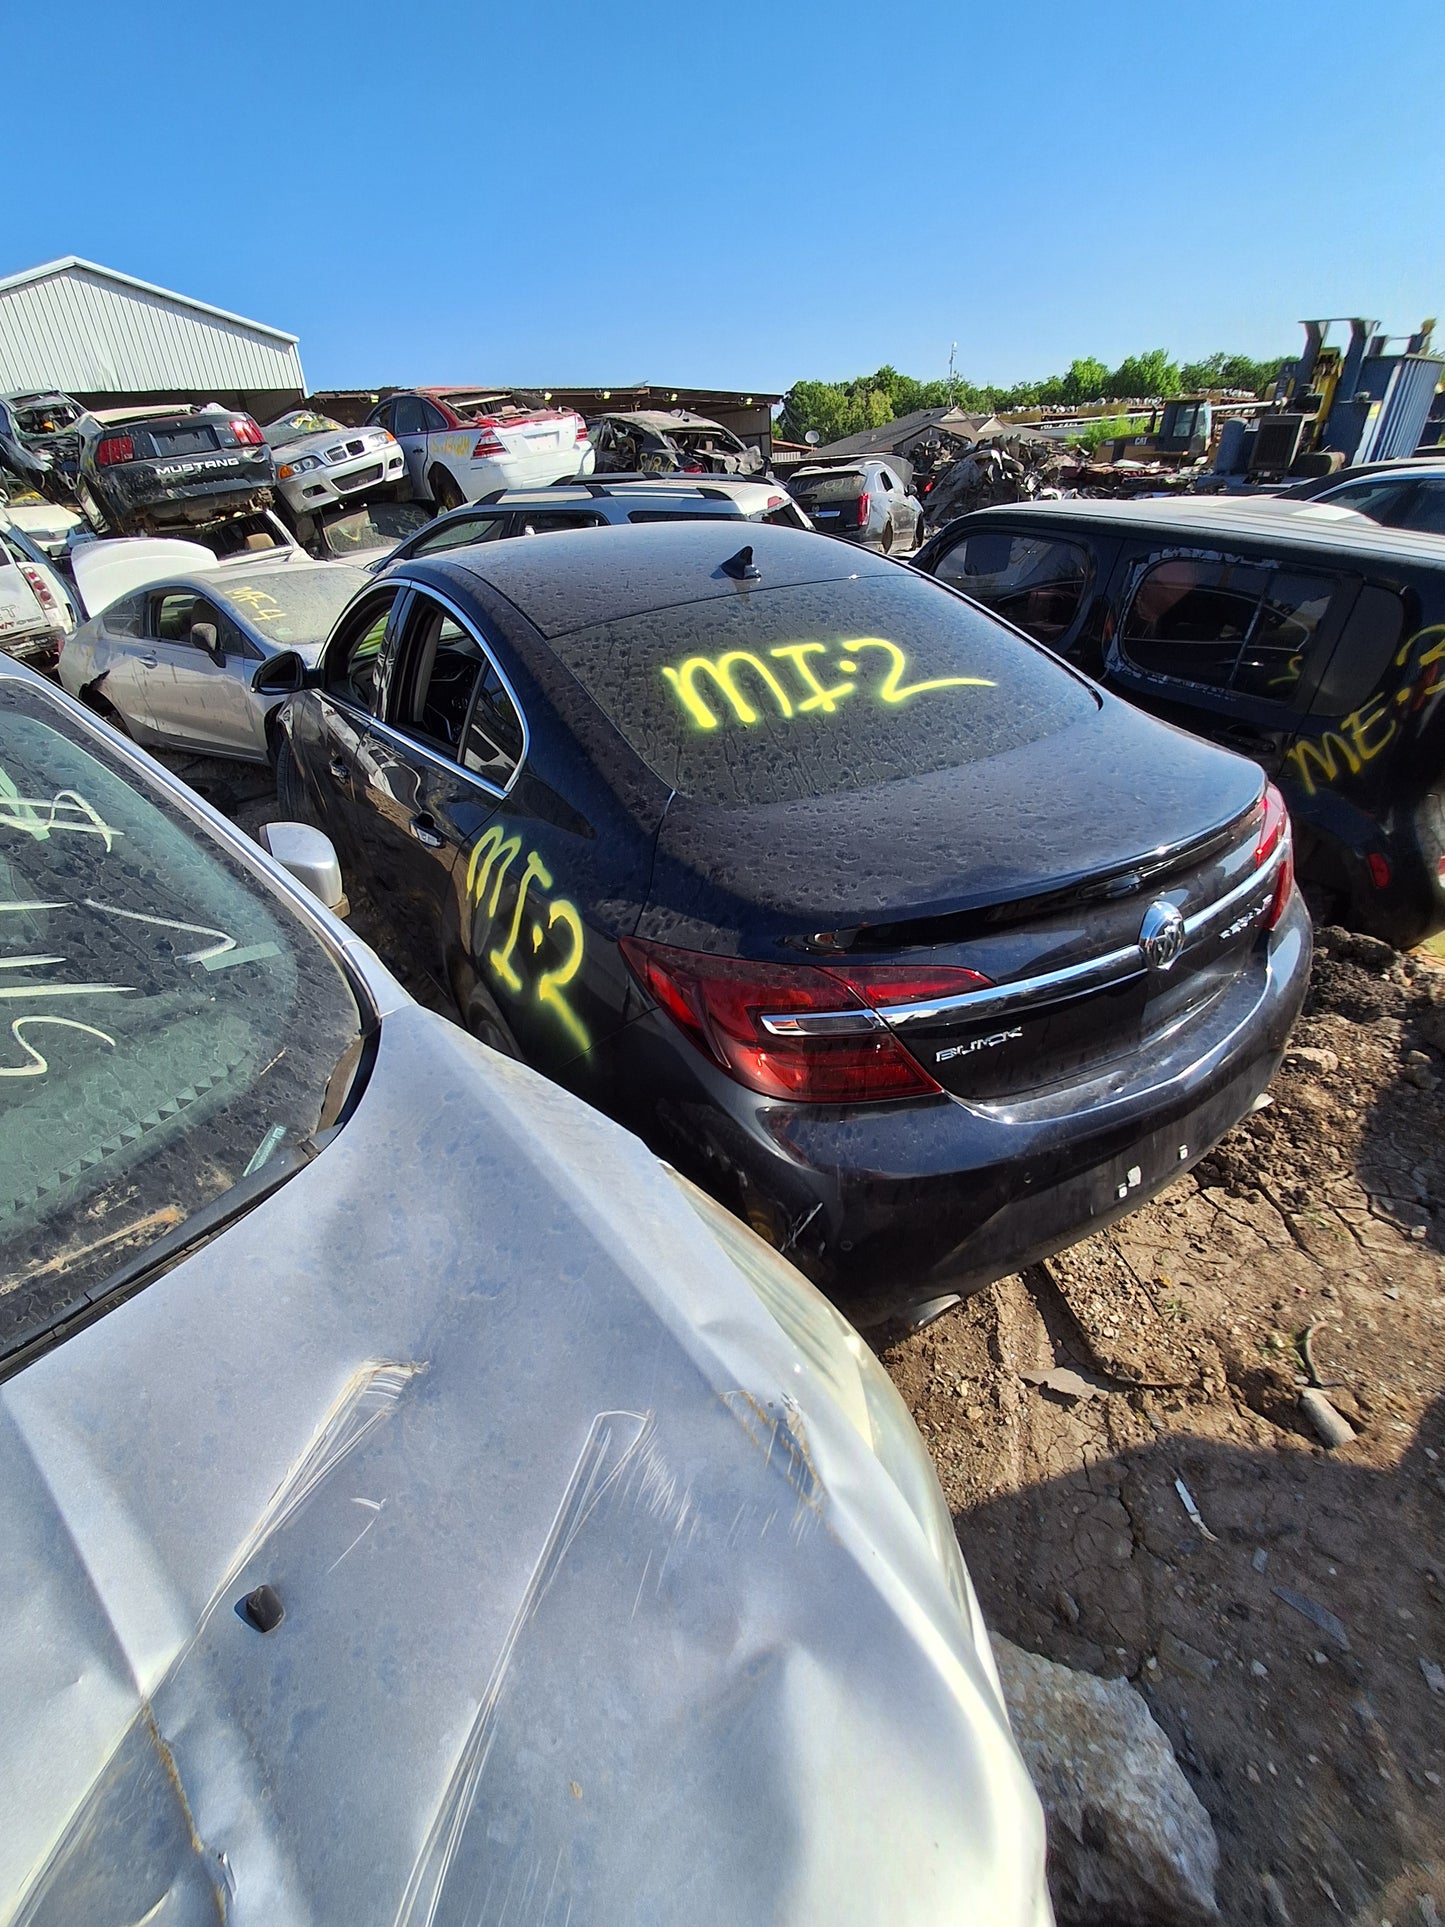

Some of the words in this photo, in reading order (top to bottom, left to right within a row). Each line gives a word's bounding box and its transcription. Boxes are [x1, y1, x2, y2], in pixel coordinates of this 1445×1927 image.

[1134, 437, 1148, 446] CAT
[156, 457, 240, 476] MUSTANG
[936, 1026, 1023, 1062] BUICK
